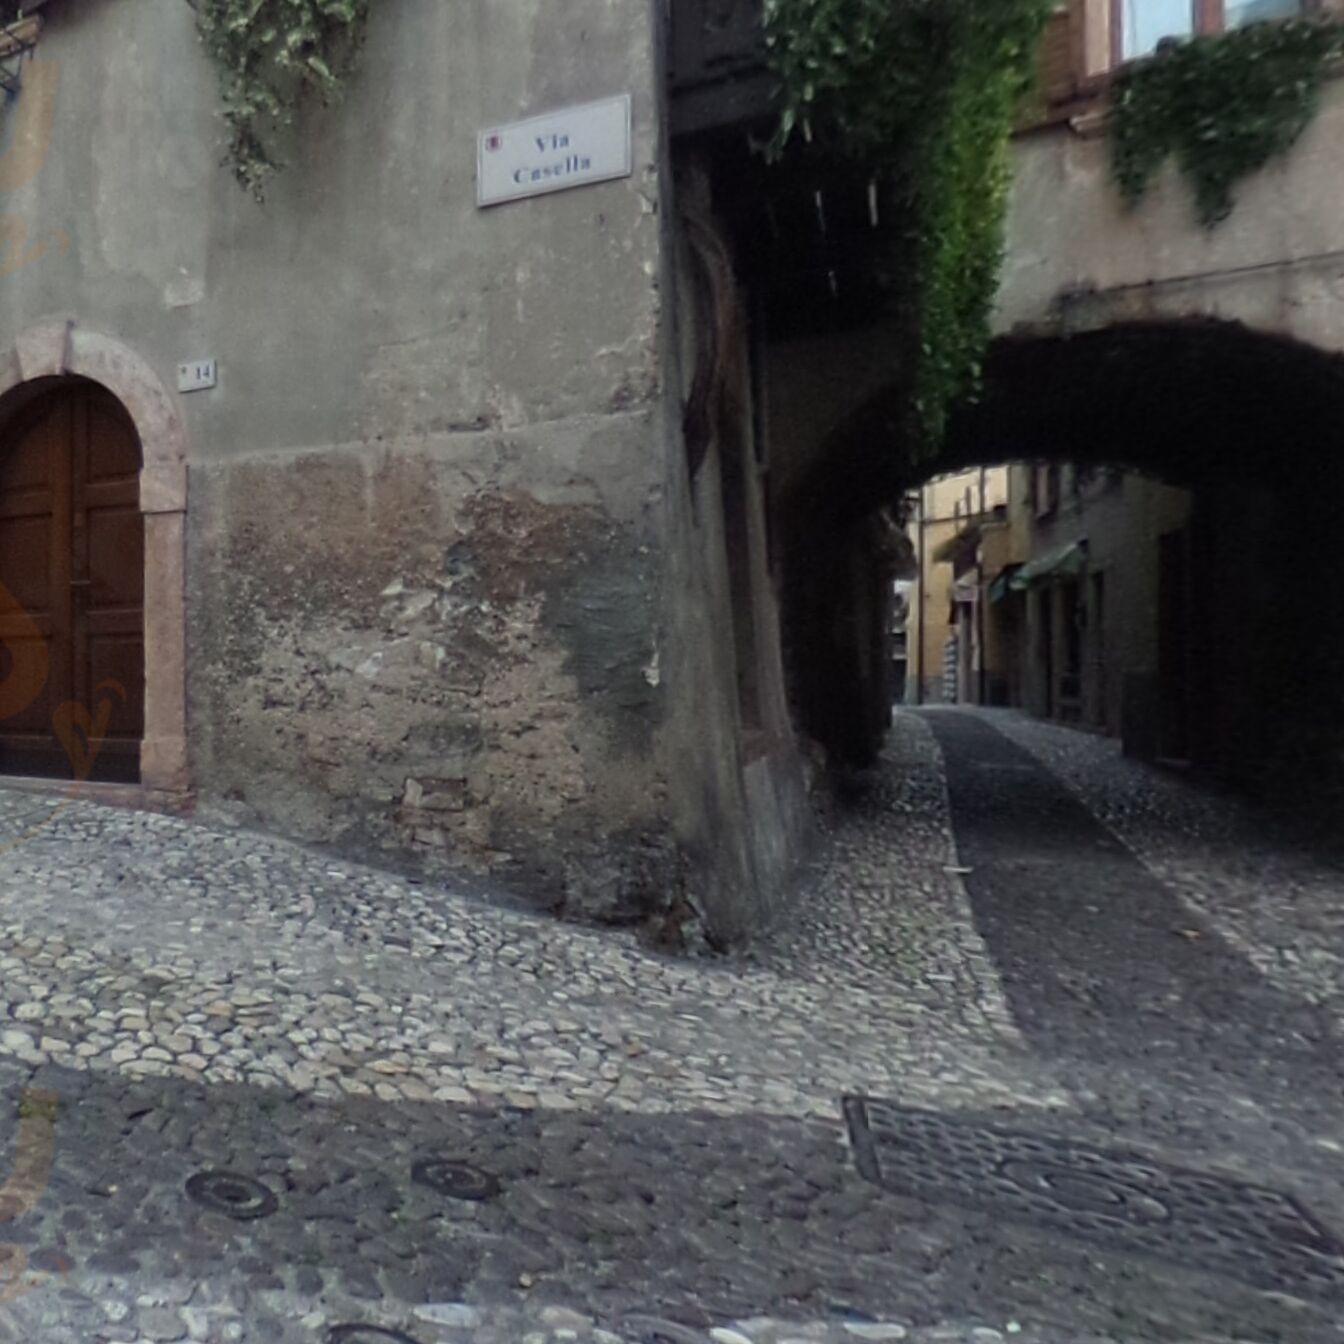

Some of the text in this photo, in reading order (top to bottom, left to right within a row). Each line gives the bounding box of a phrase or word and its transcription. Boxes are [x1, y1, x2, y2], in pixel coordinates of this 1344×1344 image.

[535, 134, 570, 152] Via
[513, 154, 592, 184] Casella
[196, 364, 211, 380] 14
